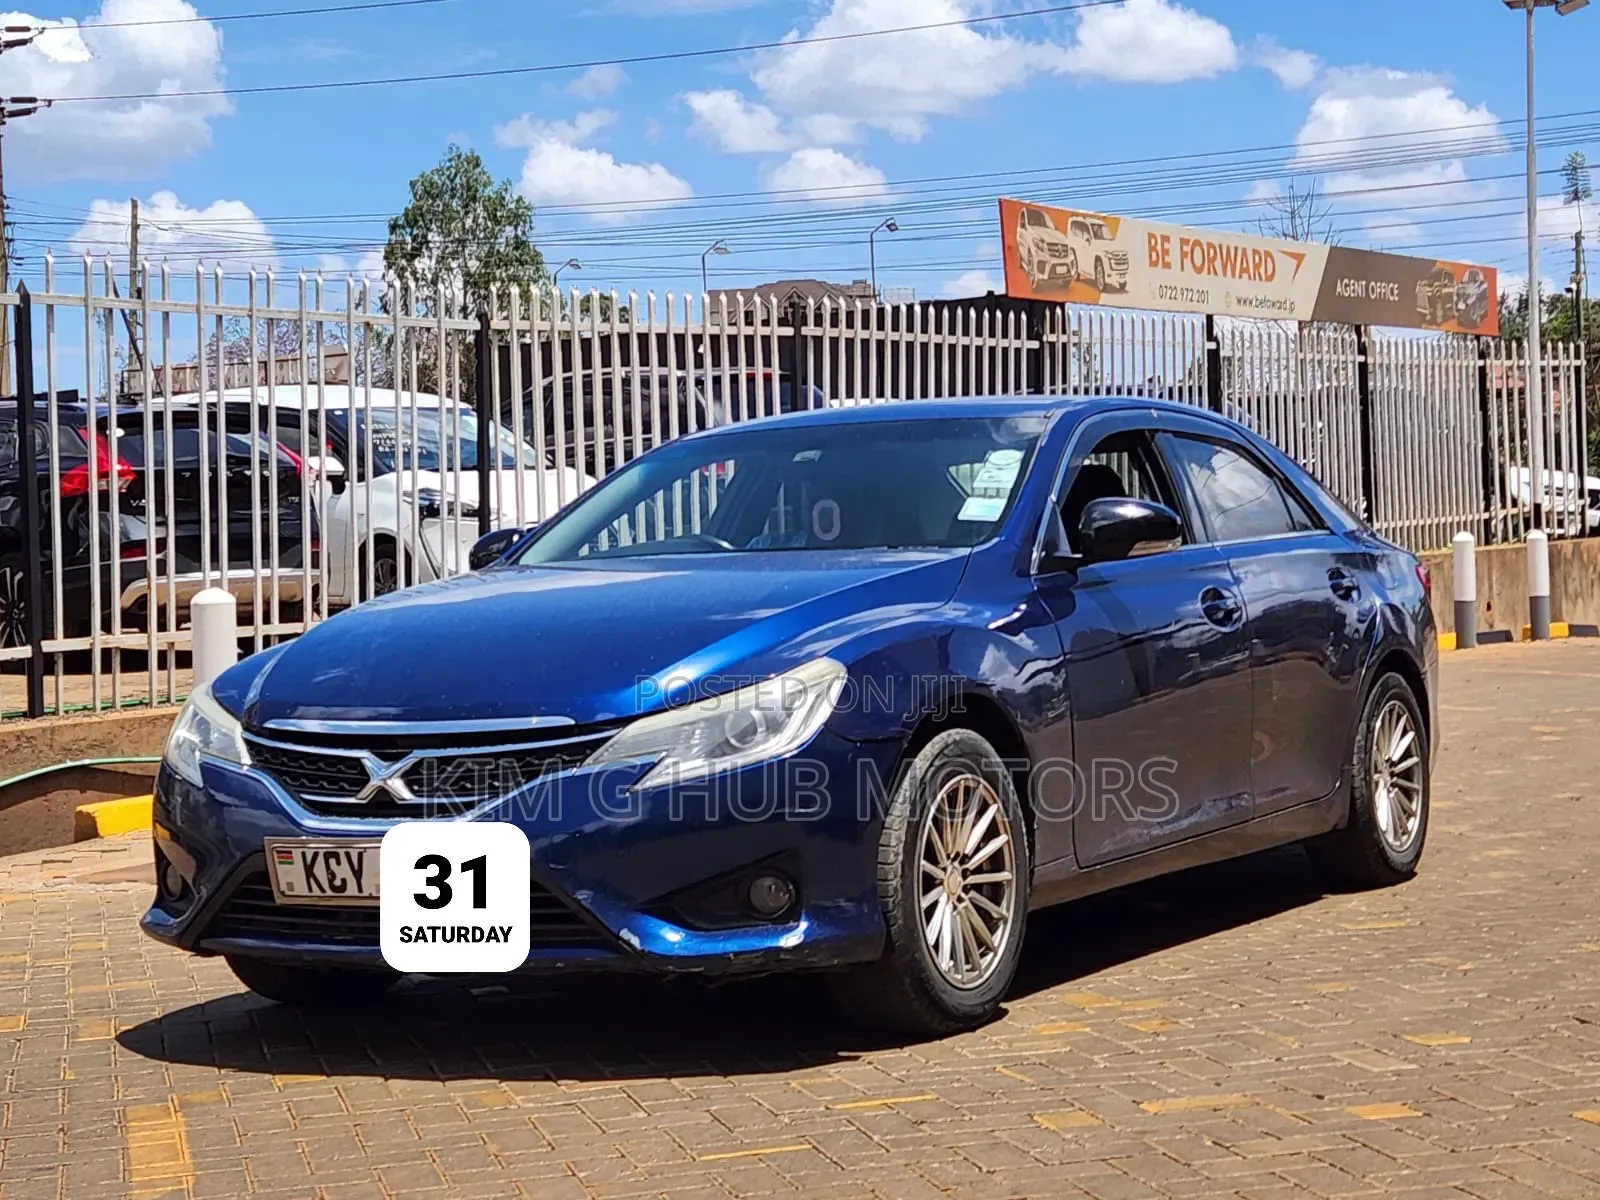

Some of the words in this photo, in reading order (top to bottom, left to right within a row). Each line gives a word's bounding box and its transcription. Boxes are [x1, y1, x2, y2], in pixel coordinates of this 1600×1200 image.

[1147, 231, 1171, 270] BE
[1179, 236, 1276, 282] FORWARD
[1159, 284, 1178, 300] 0722
[1180, 286, 1194, 302] 972
[1196, 289, 1209, 304] 201
[1335, 278, 1366, 299] AGENT
[1368, 281, 1399, 301] OFFICE
